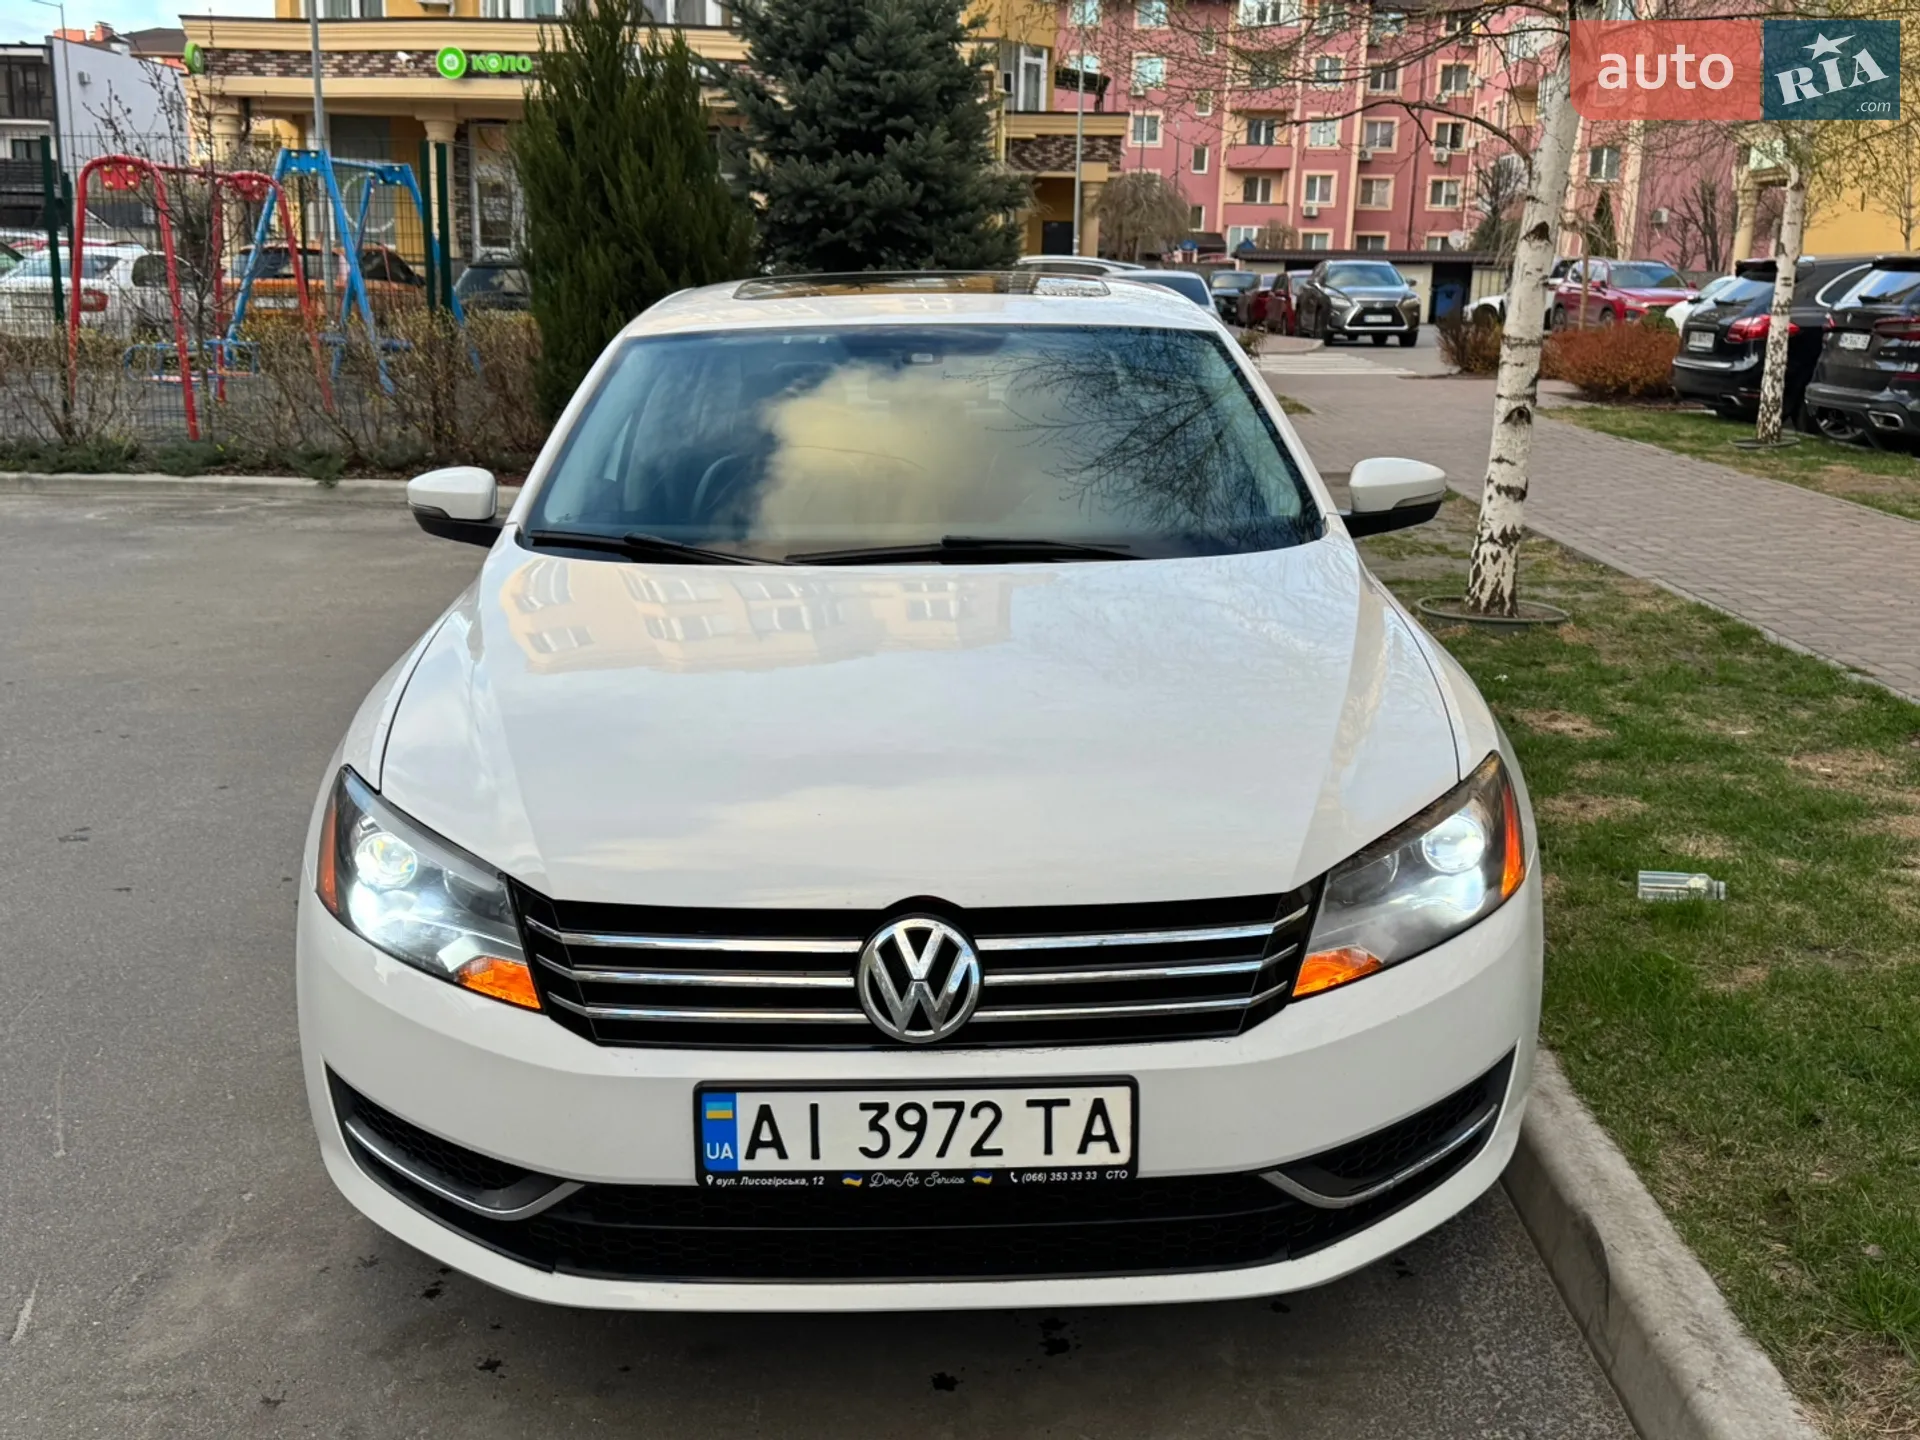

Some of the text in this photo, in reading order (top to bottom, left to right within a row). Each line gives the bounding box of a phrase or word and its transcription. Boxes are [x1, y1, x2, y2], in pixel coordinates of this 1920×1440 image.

[744, 1097, 1120, 1160] AI 3972 TA
[706, 1143, 734, 1160] UA
[716, 1176, 825, 1187] вул. Лисогірська, 12
[924, 1171, 965, 1187] Service
[1021, 1169, 1128, 1184] (066) 353 33 33 СТО
